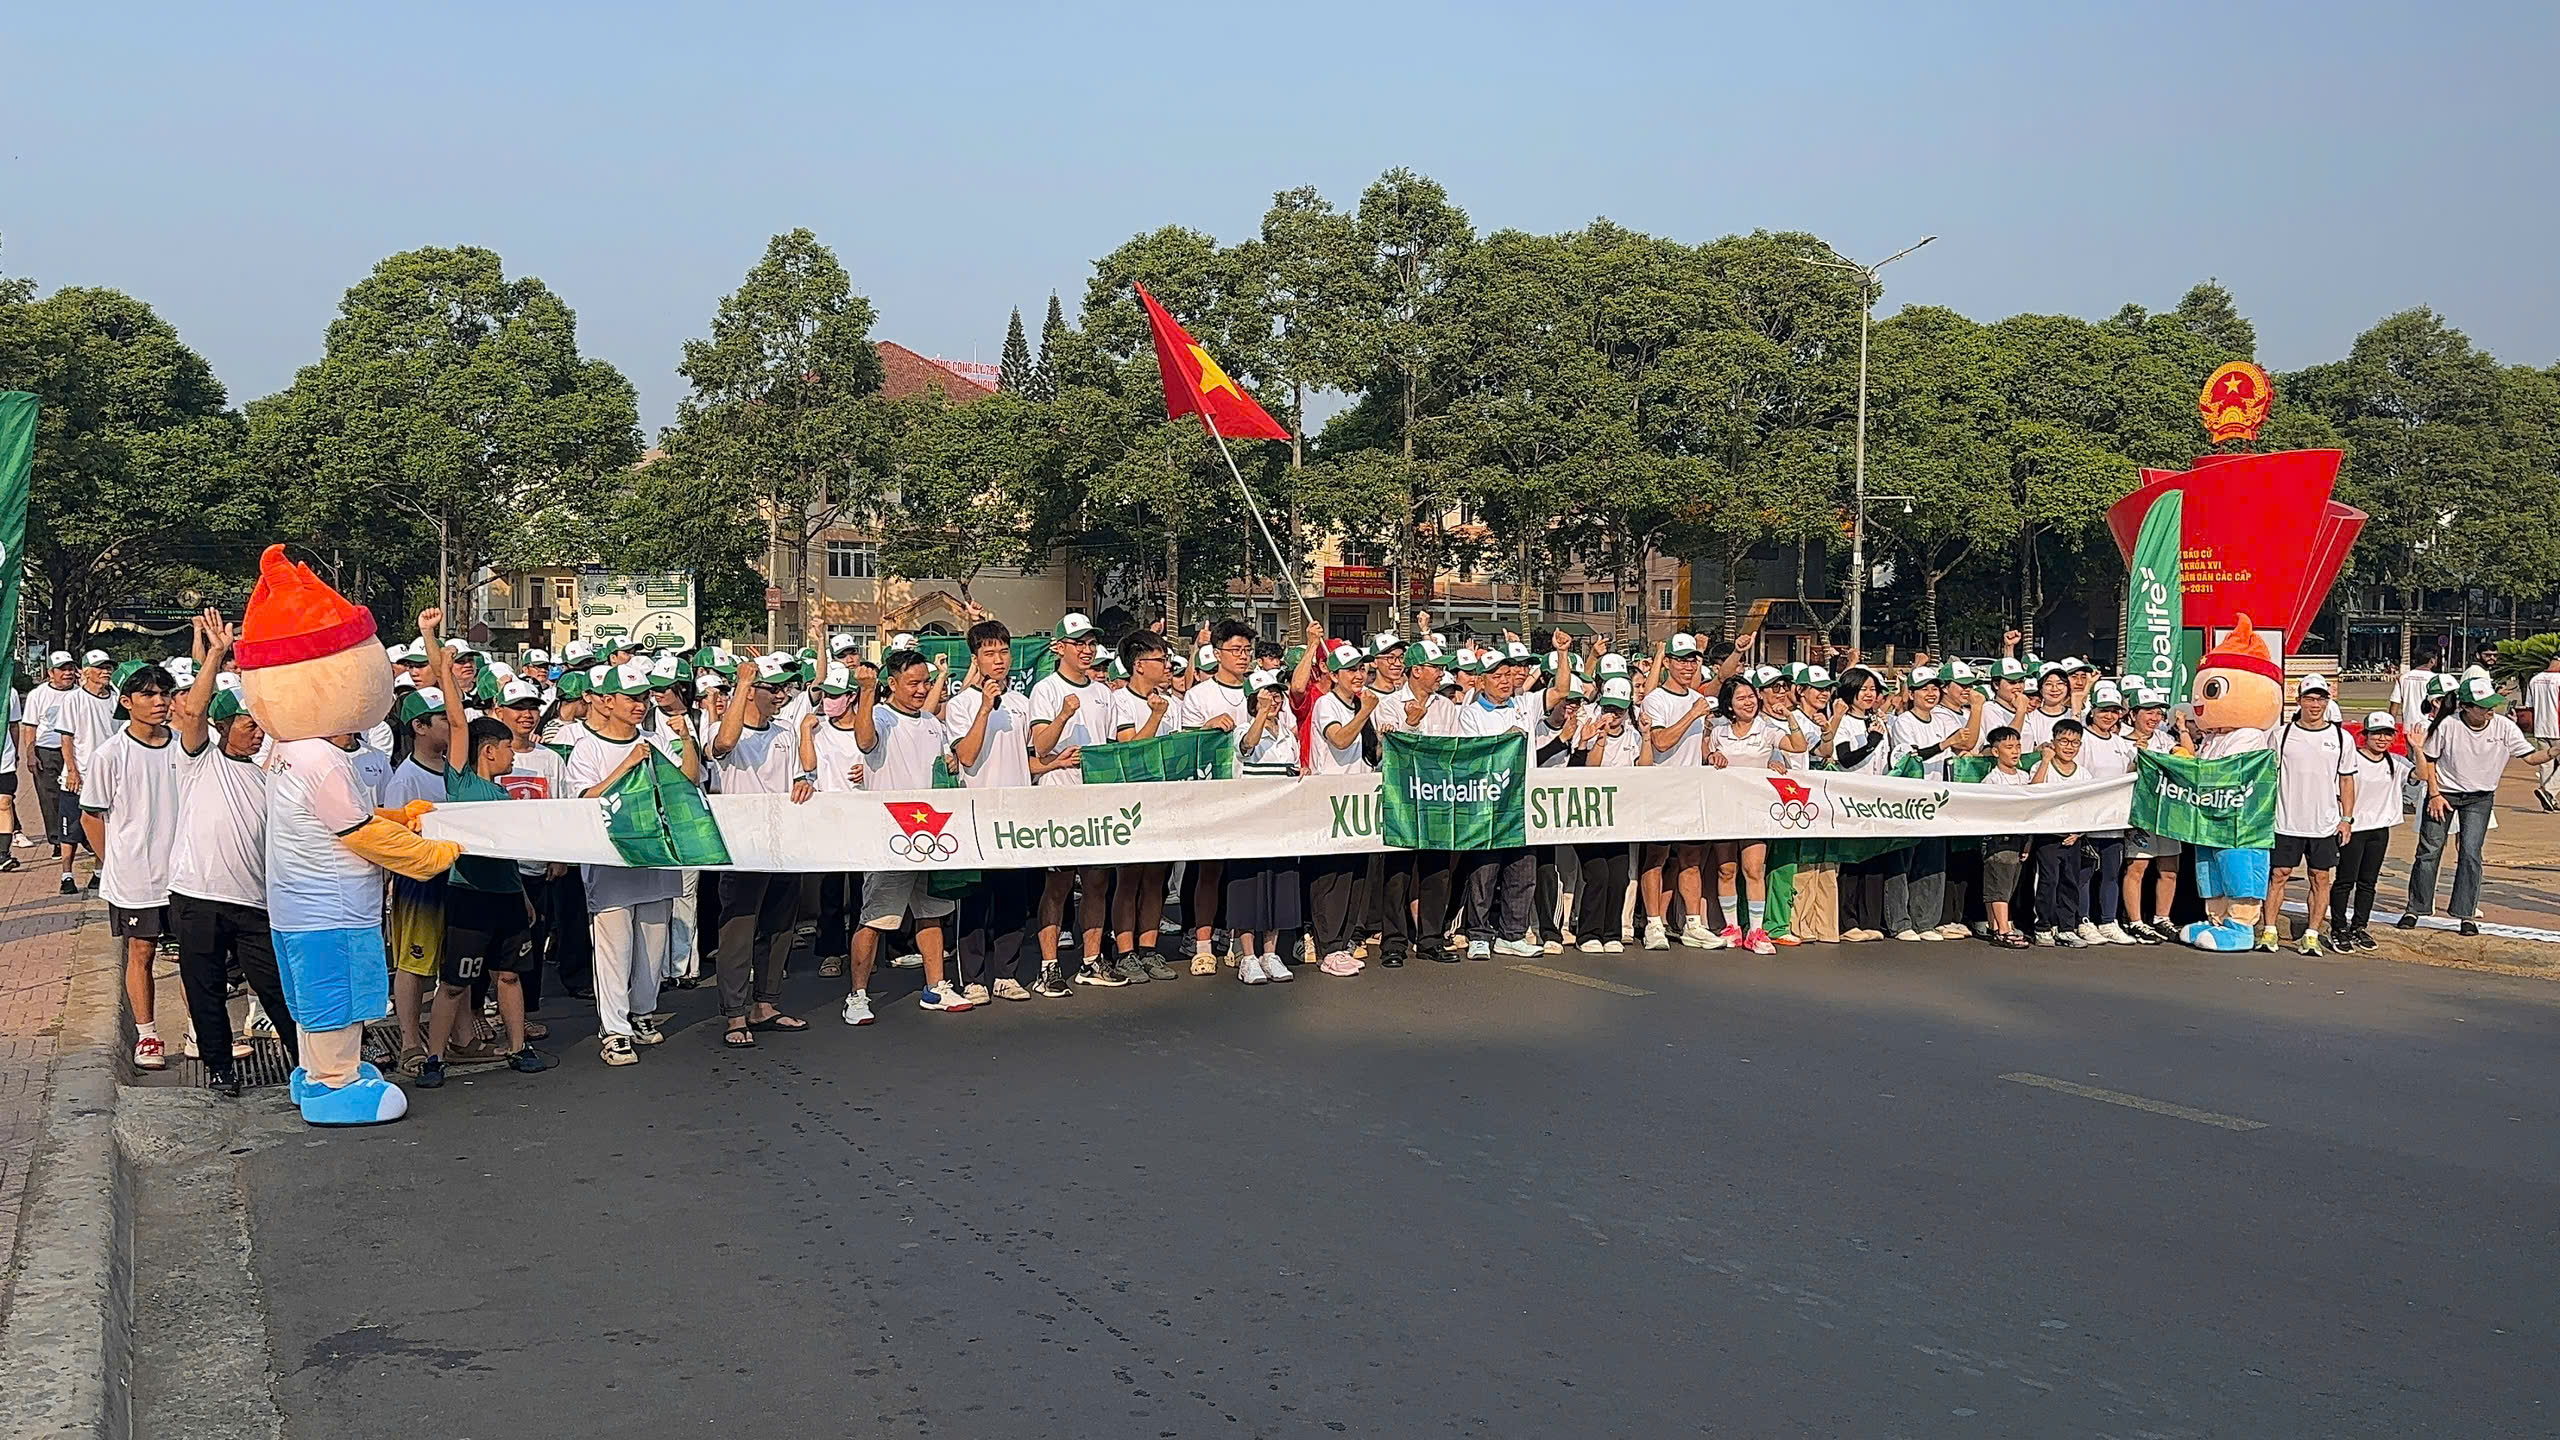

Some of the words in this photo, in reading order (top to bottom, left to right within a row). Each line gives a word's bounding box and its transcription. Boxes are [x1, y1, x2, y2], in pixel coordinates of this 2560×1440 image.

[2180, 571, 2196, 582] HÂN
[2216, 570, 2233, 581] CÁC
[2208, 561, 2222, 570] XVI
[2145, 582, 2173, 702] rbalife
[1409, 775, 1501, 803] Herbalife
[2155, 770, 2245, 809] Herbalife
[1531, 785, 1618, 829] START
[1839, 796, 1937, 821] Herbalife
[994, 816, 1132, 849] Herbalife
[459, 956, 484, 978] 03
